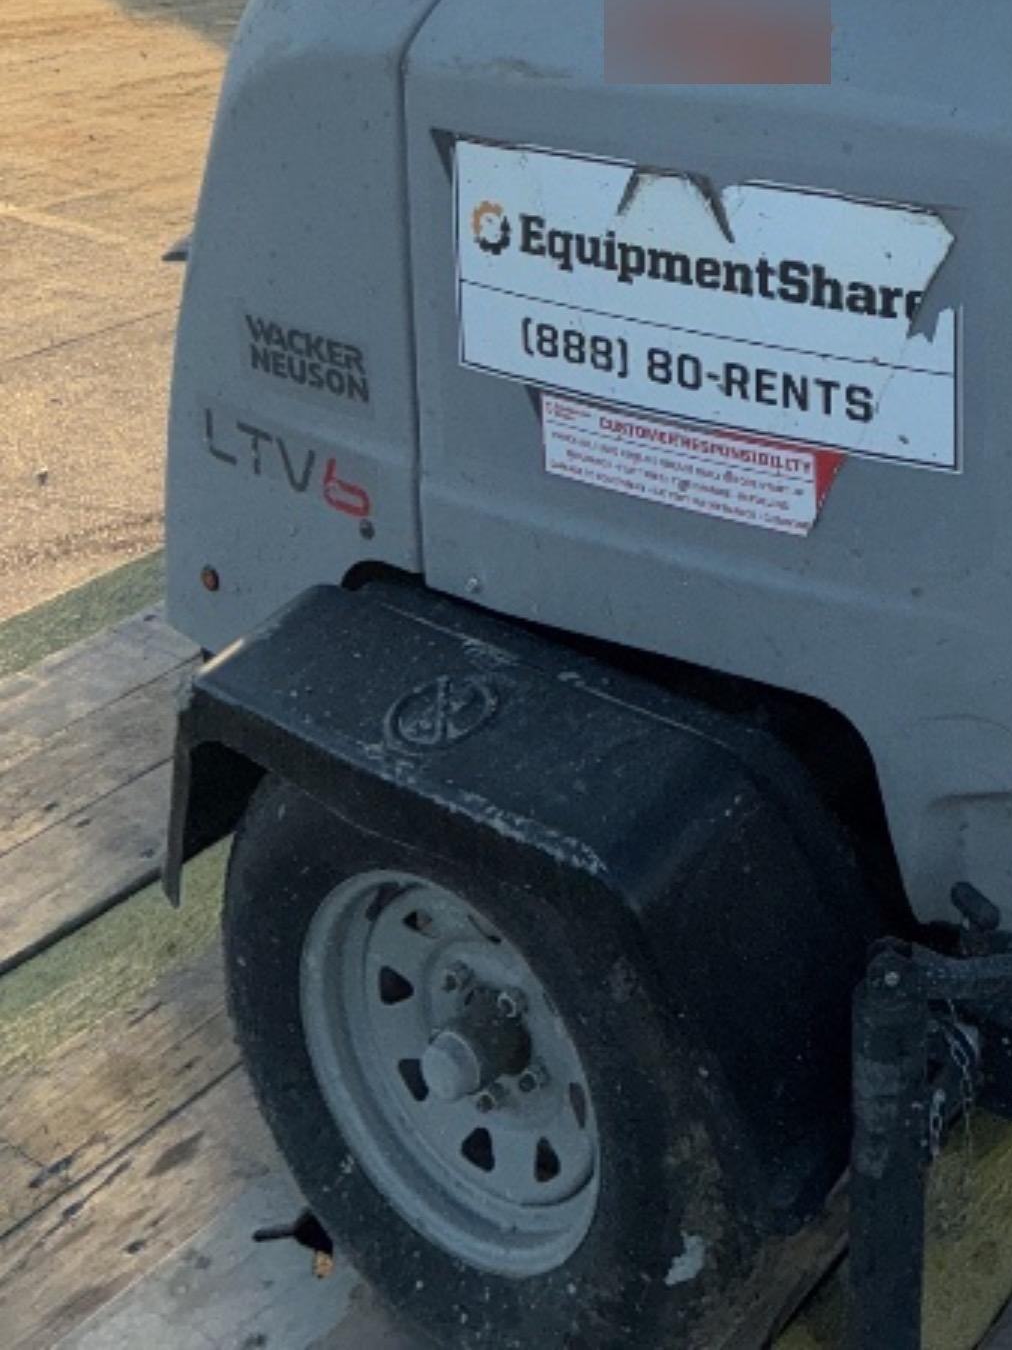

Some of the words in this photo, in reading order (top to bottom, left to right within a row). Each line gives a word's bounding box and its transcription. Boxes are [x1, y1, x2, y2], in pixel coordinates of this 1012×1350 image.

[245, 314, 366, 377] WACKER
[249, 343, 369, 402] NEUSON
[521, 316, 629, 379] (888)
[647, 347, 876, 424] 80-RENTS
